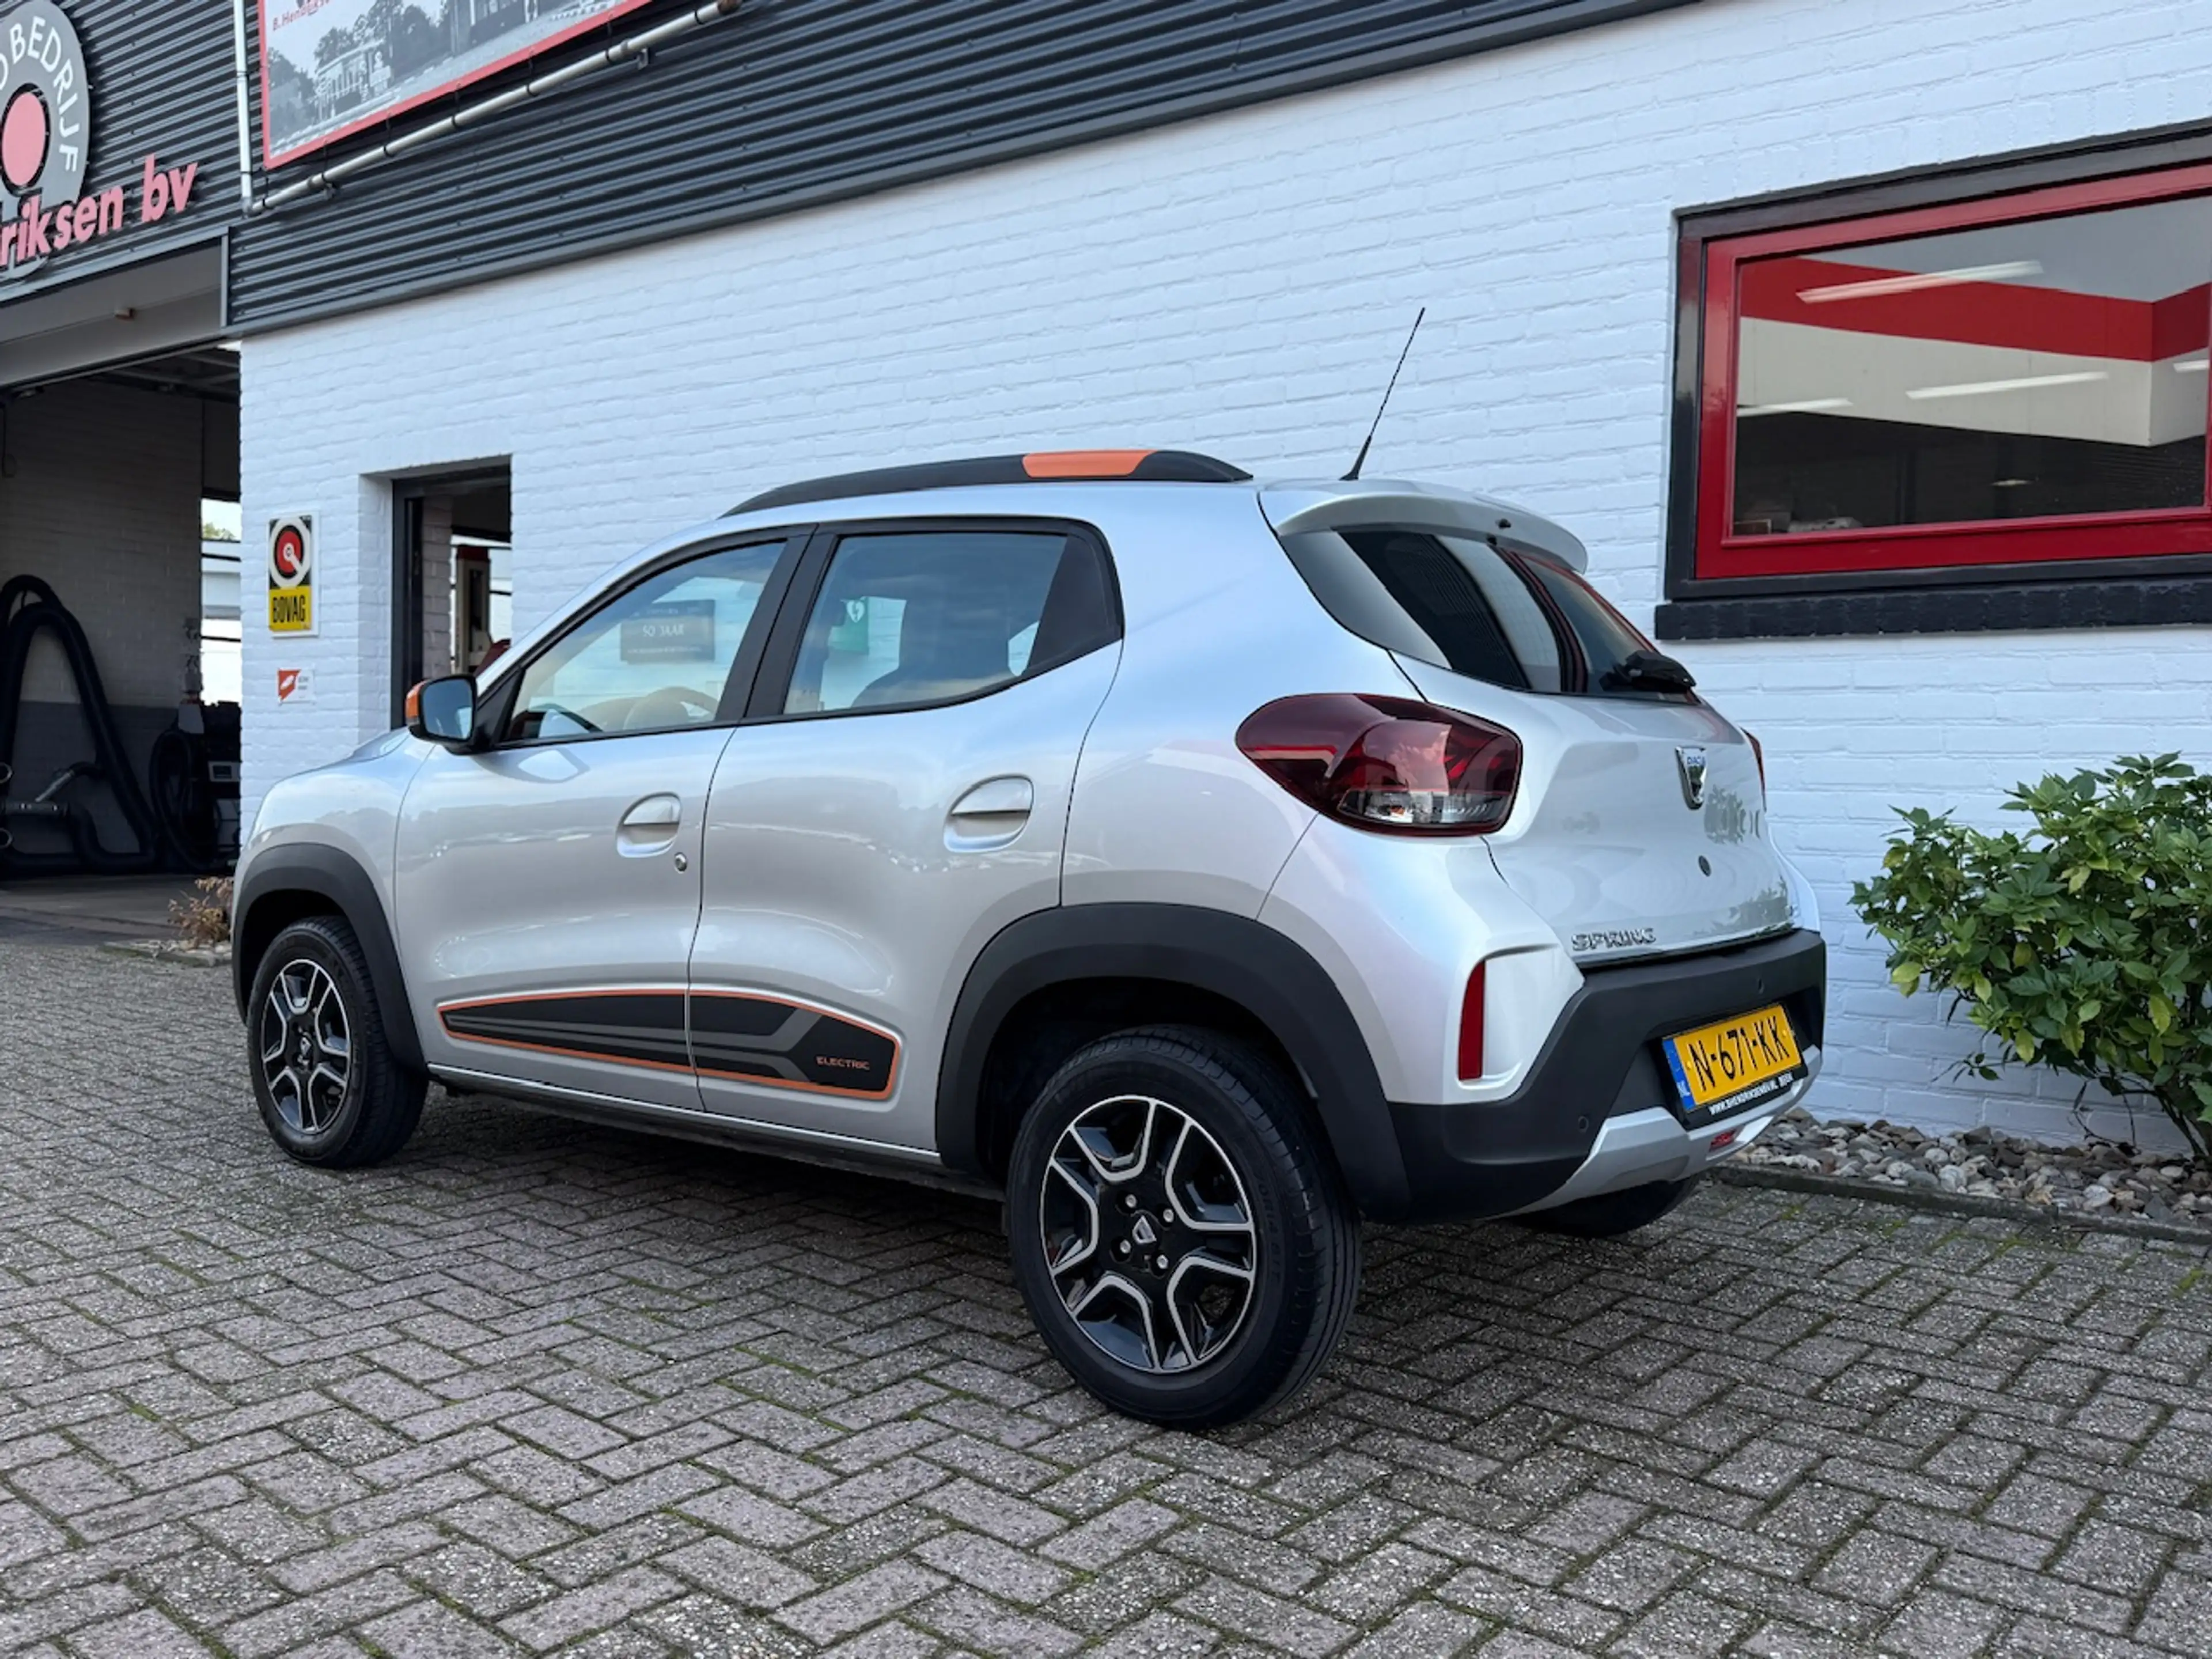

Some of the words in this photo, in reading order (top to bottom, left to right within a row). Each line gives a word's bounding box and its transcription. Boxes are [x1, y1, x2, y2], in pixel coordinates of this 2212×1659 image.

[141, 153, 198, 223] bv
[272, 594, 305, 623] BOVAG
[1571, 927, 1657, 951] SPRING
[816, 1055, 870, 1071] ELECTRIC
[1688, 1015, 1790, 1093] N-671-KK
